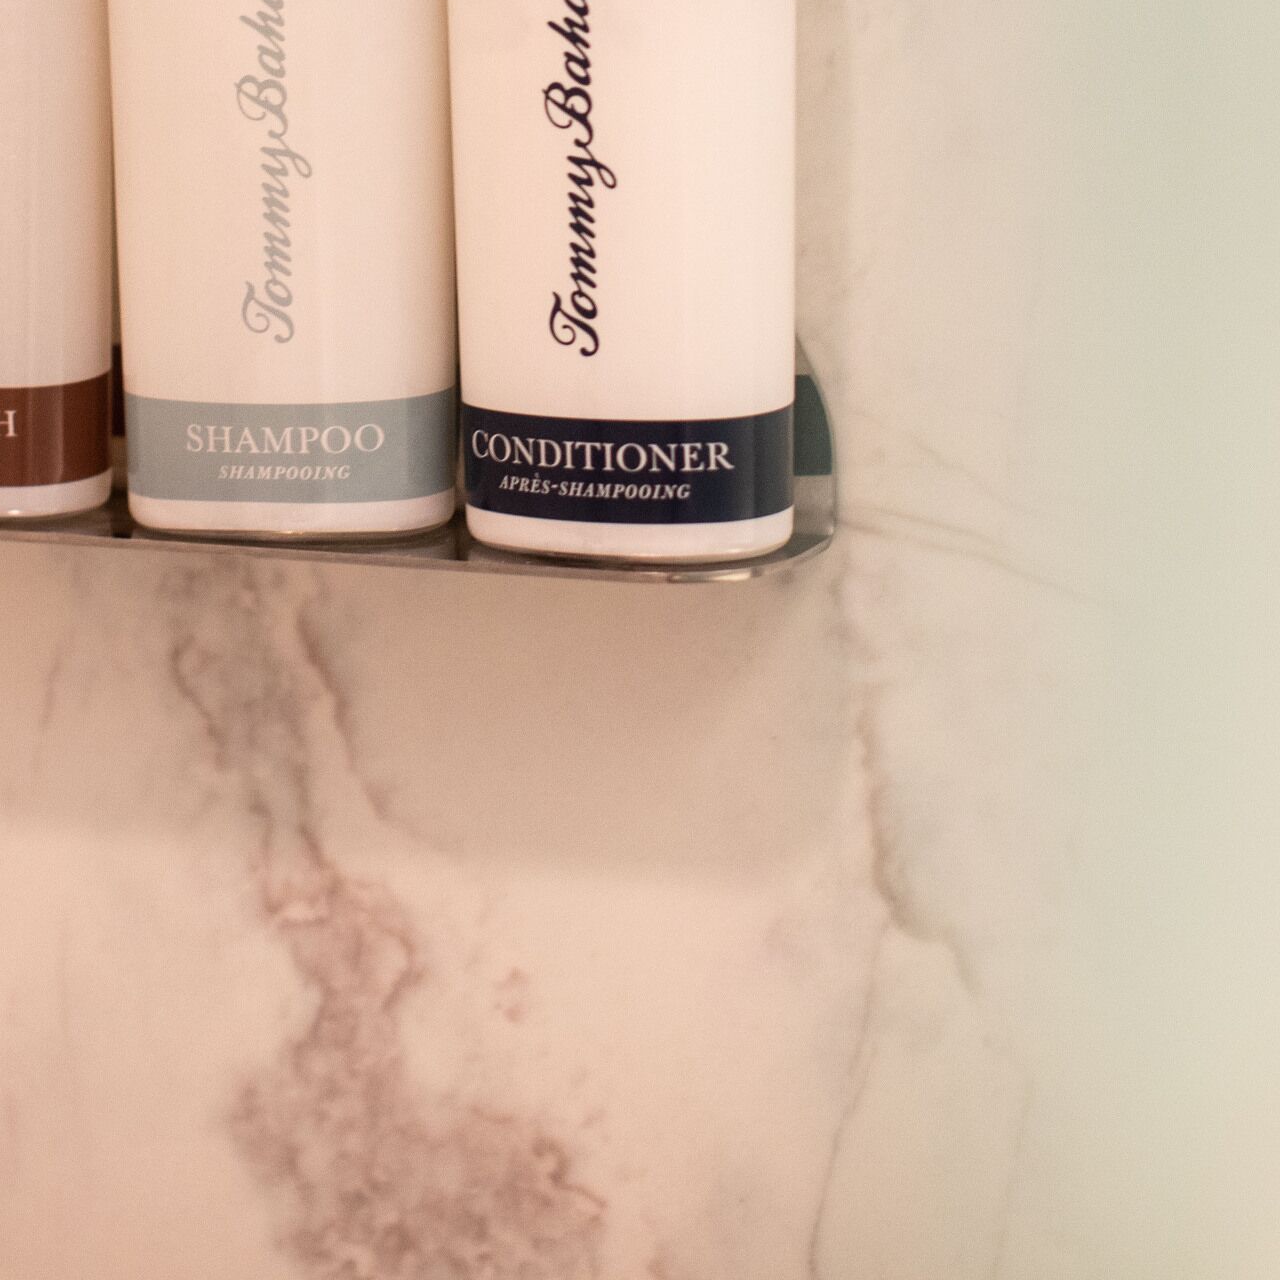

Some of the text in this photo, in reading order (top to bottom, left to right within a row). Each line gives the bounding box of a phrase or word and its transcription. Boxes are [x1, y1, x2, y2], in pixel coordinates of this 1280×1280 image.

[185, 423, 385, 455] SHAMPOO
[471, 429, 735, 473] CONDITIONER
[218, 464, 351, 481] SHAMPOOING
[499, 472, 692, 500] APRÈS-SHAMPOOING
